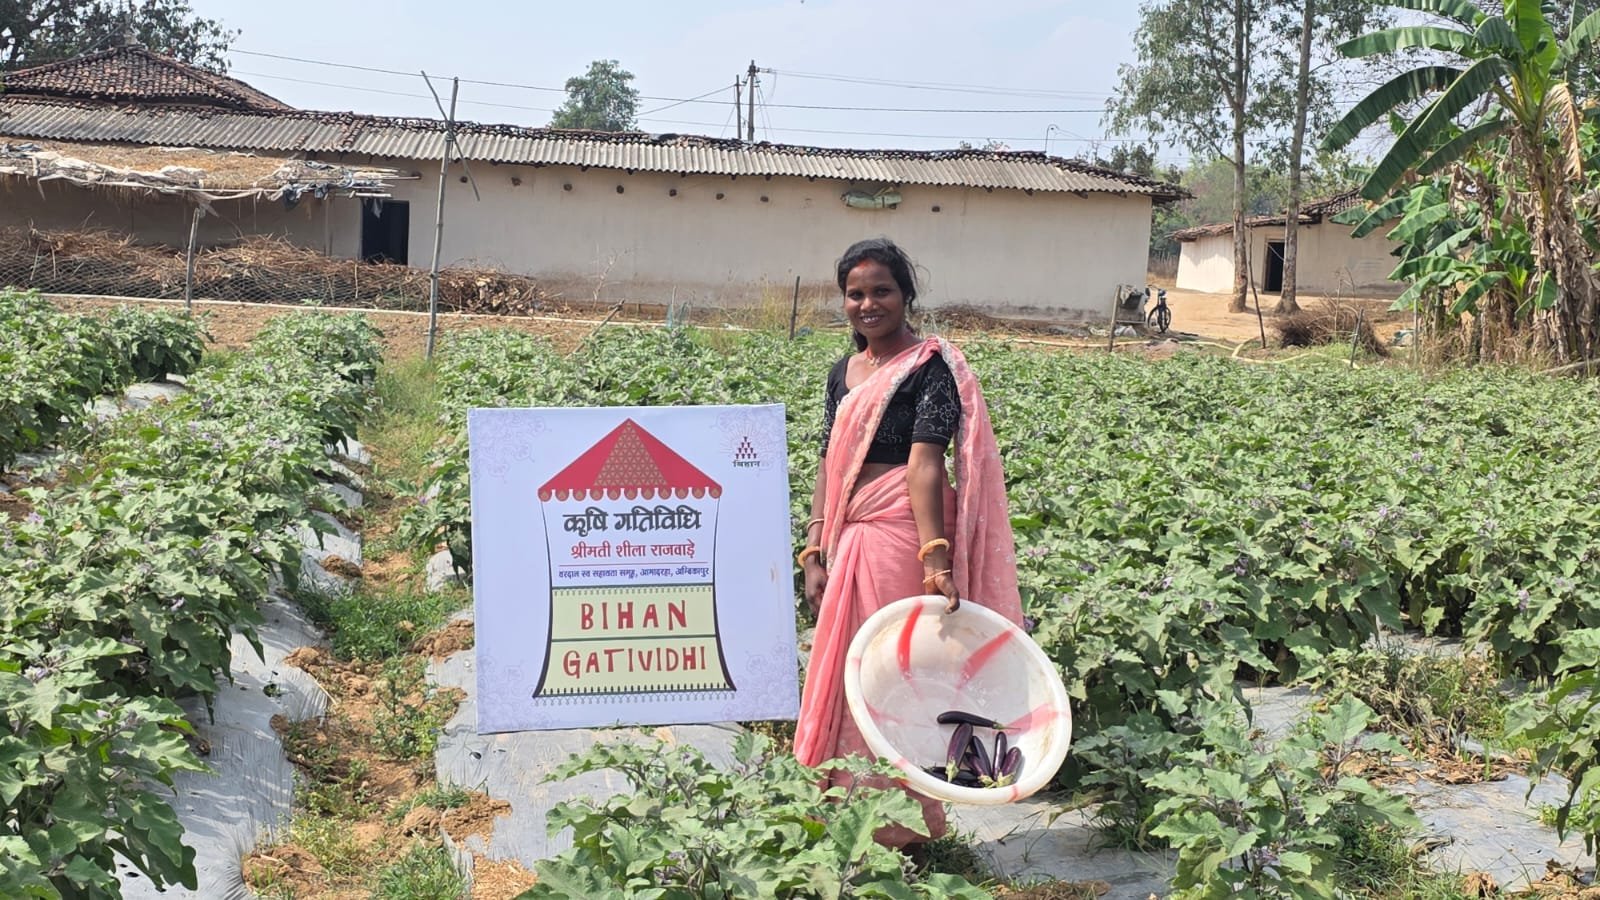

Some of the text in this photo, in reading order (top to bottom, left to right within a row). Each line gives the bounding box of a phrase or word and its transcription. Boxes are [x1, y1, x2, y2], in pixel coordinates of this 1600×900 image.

[732, 460, 761, 468] बिहान
[563, 505, 702, 537] कृषि गतिविधि
[571, 539, 696, 559] श्रीमती शीला राजवाड़े
[580, 600, 688, 631] BIHAN
[562, 646, 707, 679] GATIVIDHI
